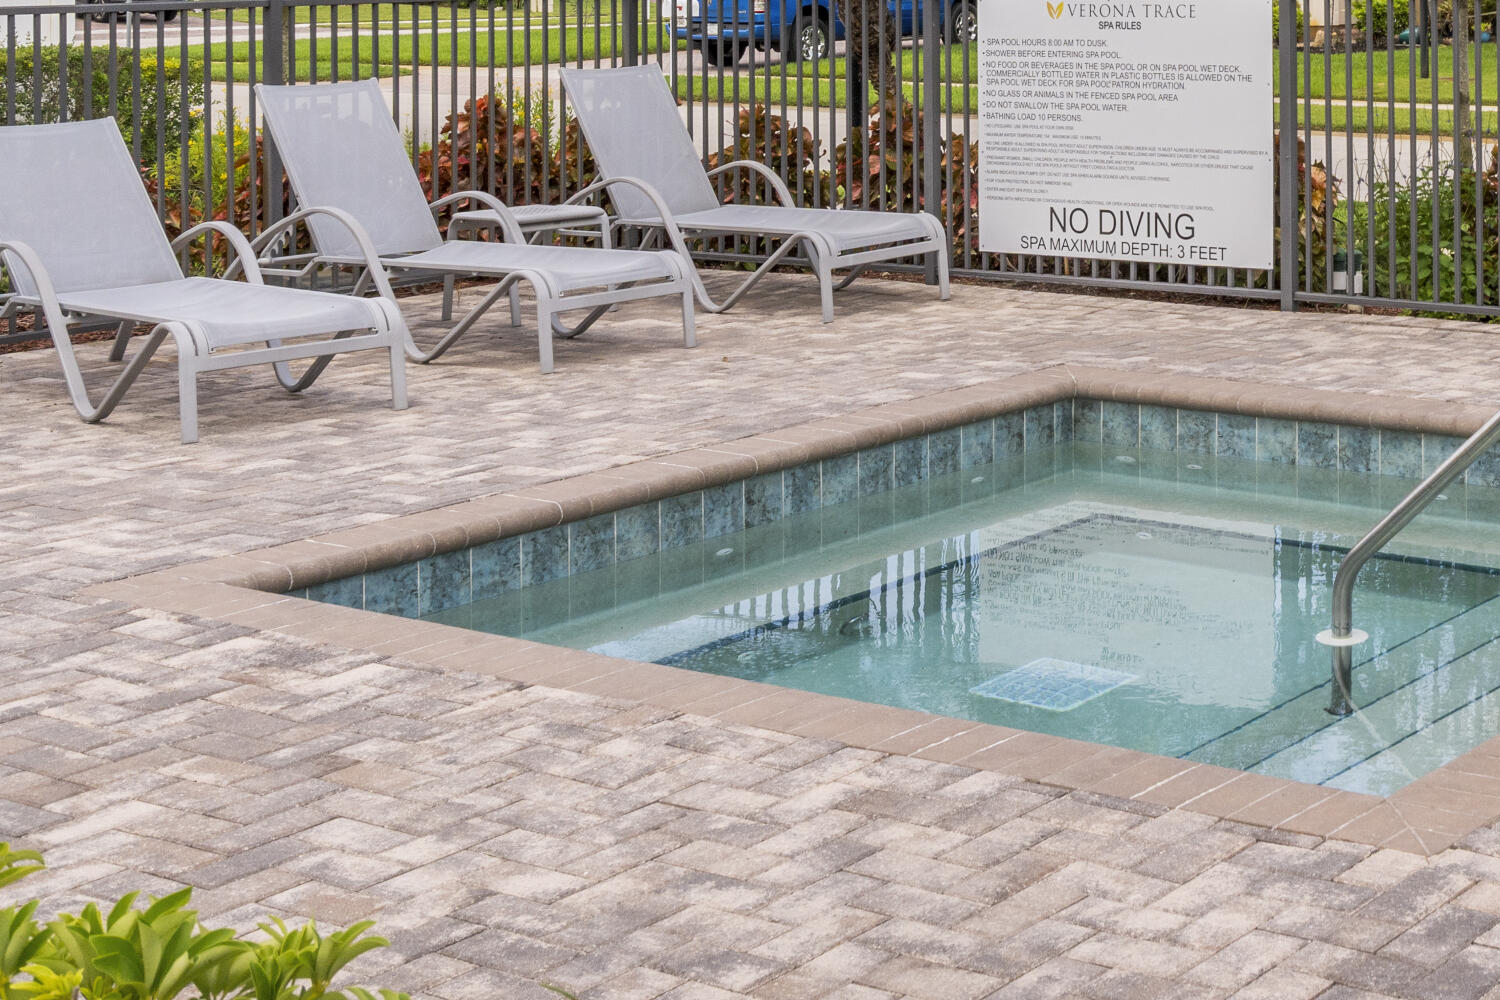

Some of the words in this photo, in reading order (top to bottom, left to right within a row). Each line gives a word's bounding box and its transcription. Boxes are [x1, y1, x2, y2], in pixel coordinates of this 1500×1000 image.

[1067, 4, 1136, 18] VERONA
[1142, 4, 1196, 19] TRACE
[1099, 21, 1113, 30] SPA
[1116, 22, 1141, 30] RULES
[987, 38, 1000, 46] SPA
[1001, 39, 1020, 47] POOL
[1021, 39, 1046, 47] HOURS
[1063, 39, 1074, 47] AM
[986, 50, 1016, 58] SHOWER
[1018, 50, 1046, 58] BEFORE
[1085, 51, 1099, 59] SPA
[998, 61, 1017, 69] FOOD
[1020, 61, 1029, 69] OR
[1031, 62, 1073, 70] BEVERAGES
[1100, 63, 1114, 71] SPA
[1115, 63, 1135, 71] POOL
[1163, 64, 1177, 72] SPA
[1178, 64, 1198, 72] POOL
[986, 70, 1040, 78] COMMERCIALLY
[1110, 72, 1140, 80] PLASTIC
[986, 78, 1000, 86] SPA
[1021, 79, 1036, 87] WET
[1038, 79, 1057, 87] DECK
[1075, 80, 1089, 88] SPA
[1112, 81, 1140, 89] PATRON
[1034, 91, 1064, 99] ANIMALS
[1090, 92, 1120, 100] FENCED
[998, 101, 1013, 109] NOT
[1014, 102, 1049, 110] SWALLOW
[1051, 102, 1064, 110] THE
[1081, 103, 1101, 111] POOL
[986, 113, 1015, 121] BATHING
[1038, 114, 1046, 122] 10
[1050, 207, 1089, 234] NO
[1099, 209, 1195, 240] DIVING
[1020, 236, 1047, 250] SPA
[1050, 237, 1117, 254] MAXIMUM
[1121, 241, 1173, 257] DEPTH:
[1177, 245, 1185, 258] 3
[1190, 246, 1227, 260] FEET
